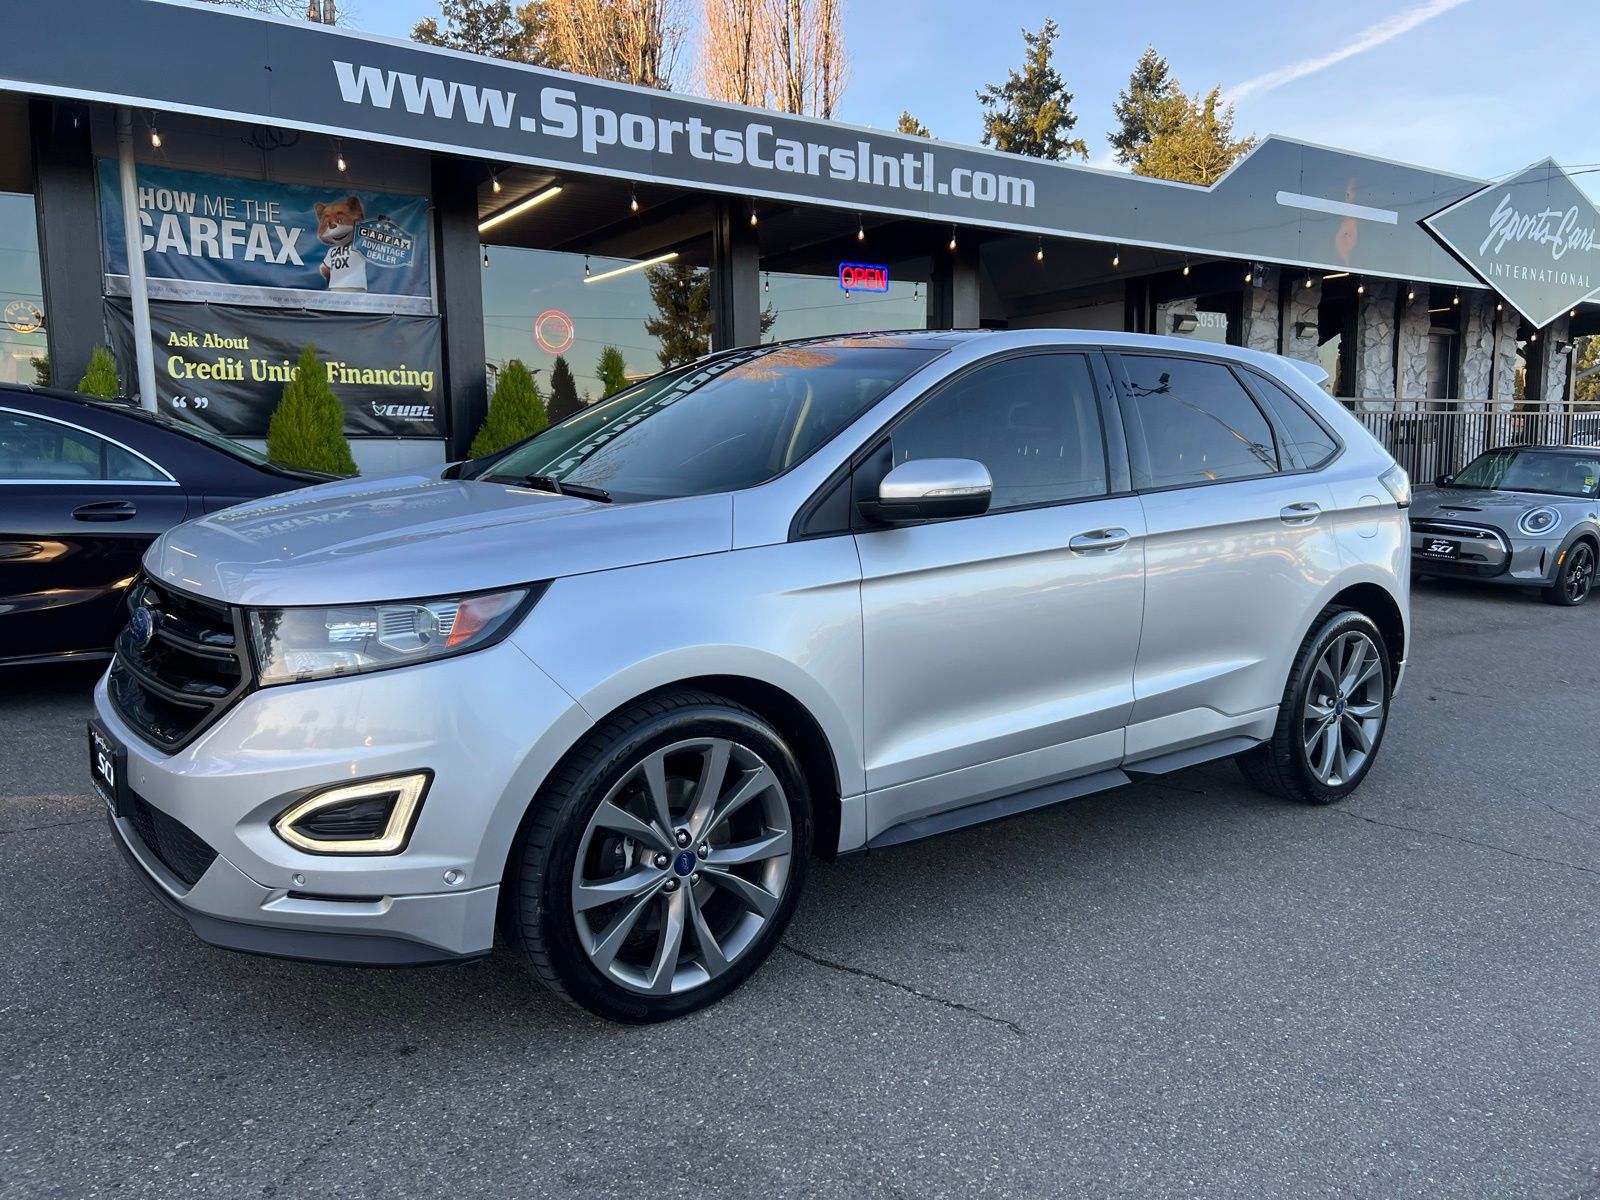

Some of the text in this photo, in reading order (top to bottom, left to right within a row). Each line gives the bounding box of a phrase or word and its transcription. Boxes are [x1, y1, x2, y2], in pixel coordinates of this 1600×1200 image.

[333, 60, 1036, 208] www.SportsCarsIntl.com
[139, 187, 281, 224] HOW ME THE
[1480, 193, 1600, 260] Sports Cars
[360, 228, 411, 250] CARFAX
[361, 240, 405, 258] ADVANTAGE
[330, 245, 351, 258] CAR
[366, 250, 397, 265] DEALER
[330, 257, 349, 269] FOX
[841, 266, 887, 289] OPEN
[1489, 262, 1591, 288] INTERNATIONAL
[168, 331, 249, 350] Ask About
[167, 355, 434, 392] Credit Uni Financing
